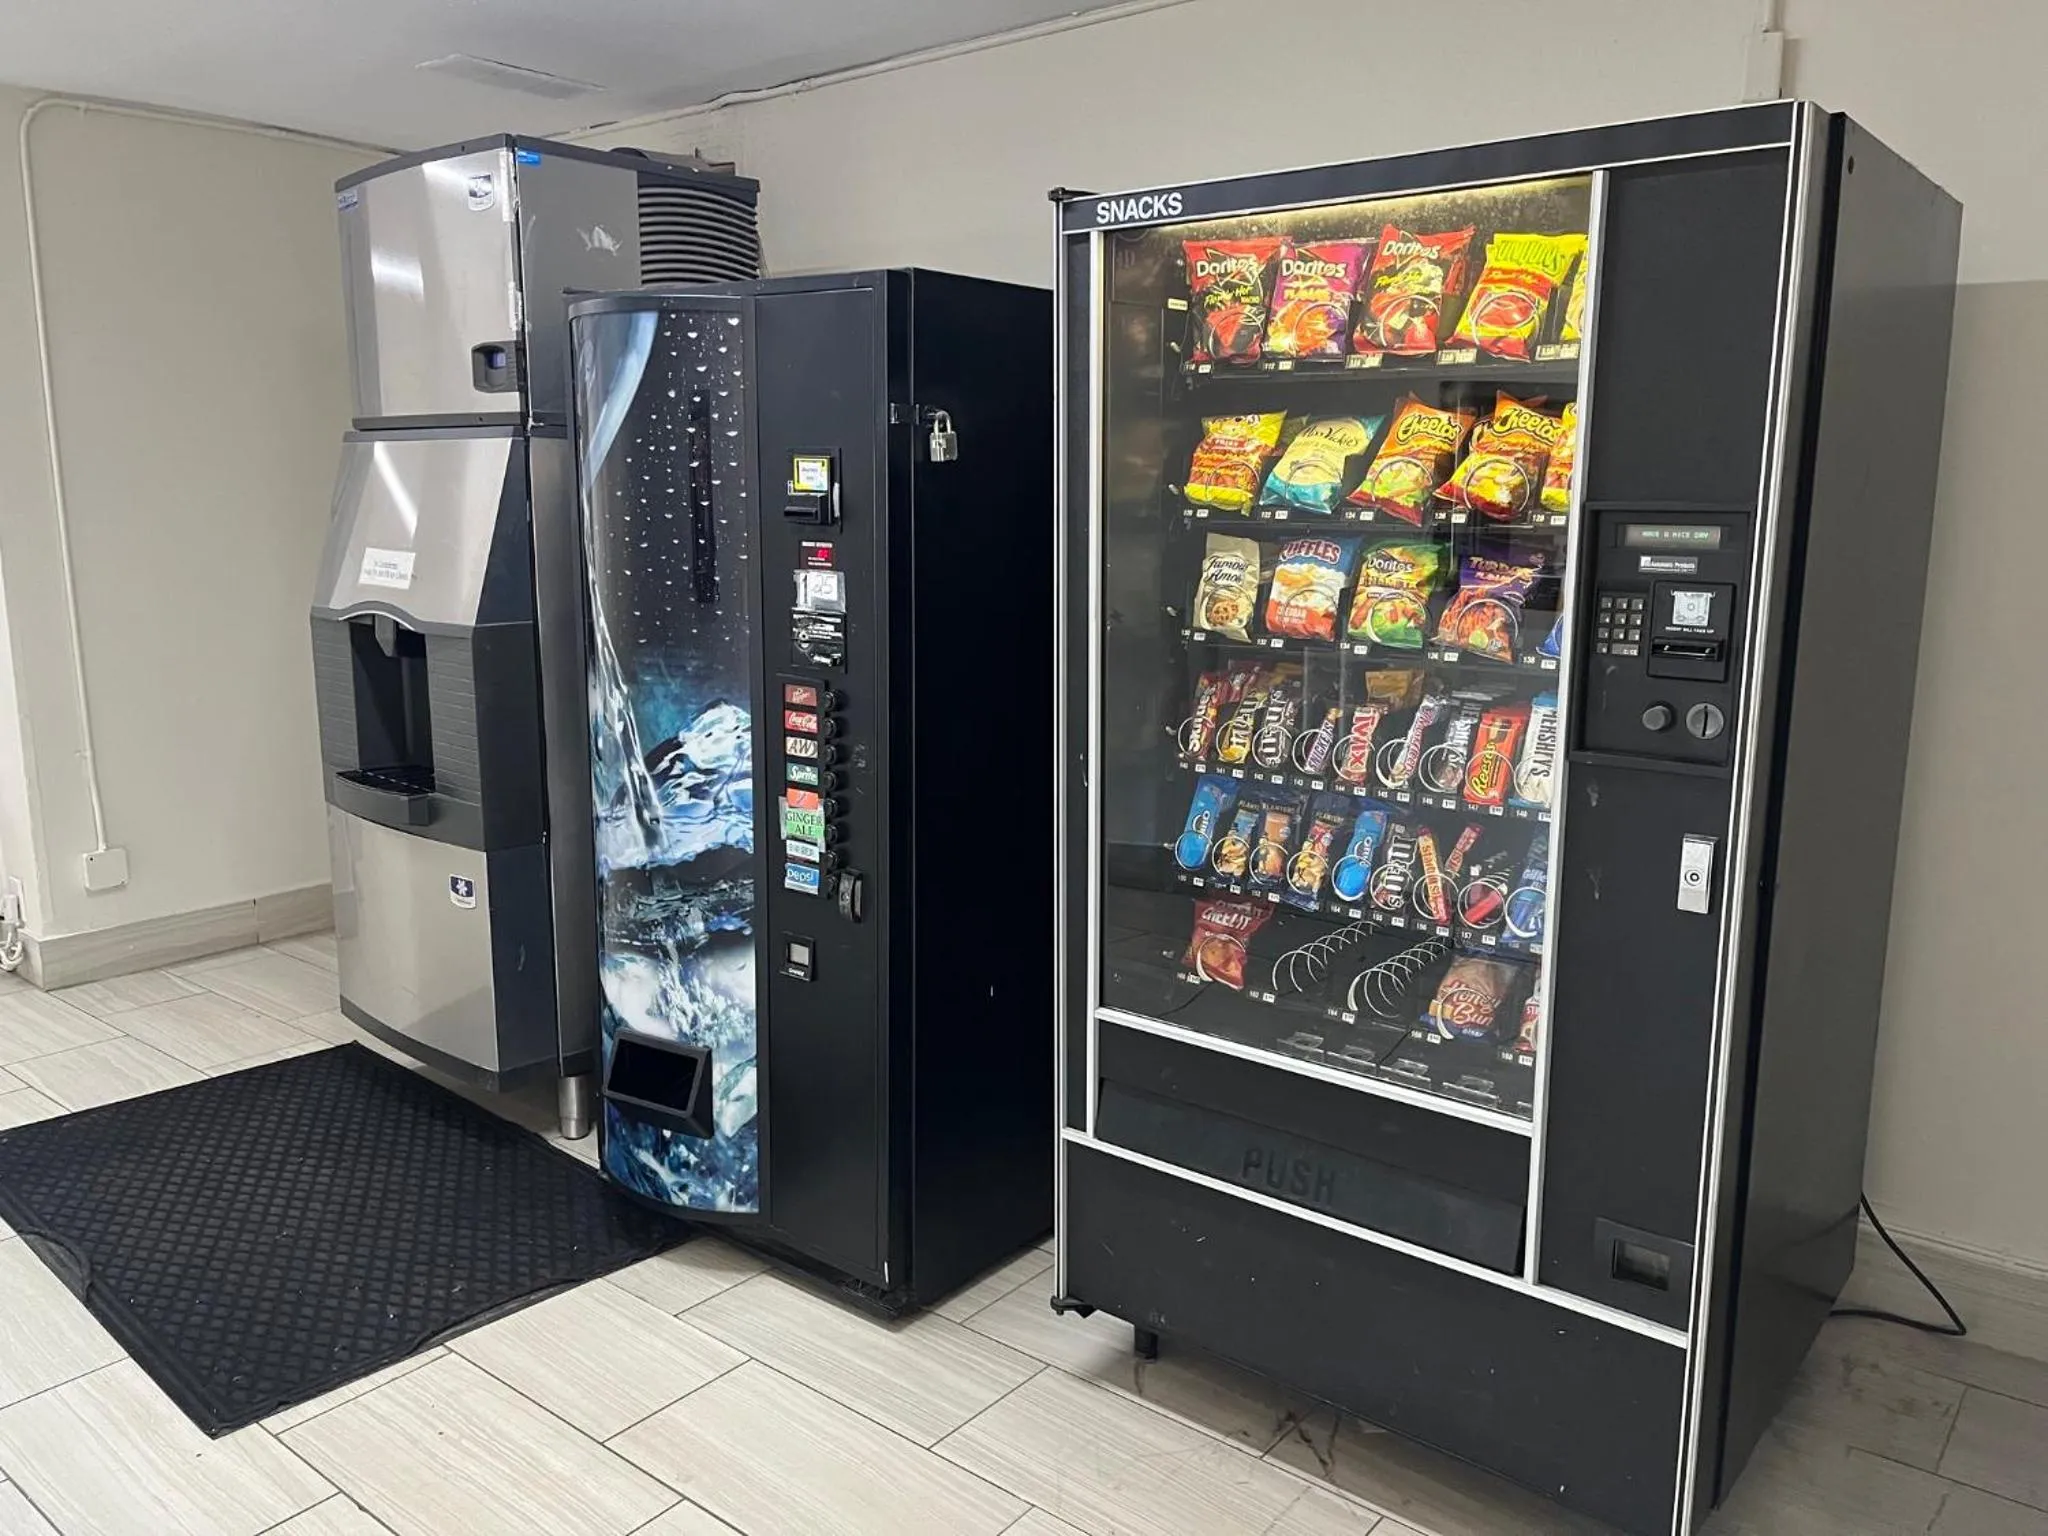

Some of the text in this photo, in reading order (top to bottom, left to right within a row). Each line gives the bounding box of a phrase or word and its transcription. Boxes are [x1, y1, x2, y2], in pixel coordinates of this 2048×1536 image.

[1096, 192, 1182, 224] SNACKS
[1382, 240, 1441, 259] Doritos
[1196, 257, 1260, 277] Doritos
[1281, 258, 1345, 277] Doritos
[1397, 413, 1461, 440] Cheetos
[1496, 407, 1562, 440] Cheetos
[1279, 538, 1341, 564] RUFFLES
[1368, 557, 1413, 573] Doritos
[1307, 719, 1336, 768] SNICKERS
[790, 765, 817, 781] Sprite
[786, 810, 823, 826] GINGER
[795, 823, 814, 836] ALE
[1452, 1001, 1494, 1026] Bun
[1241, 1148, 1337, 1204] PUSH
